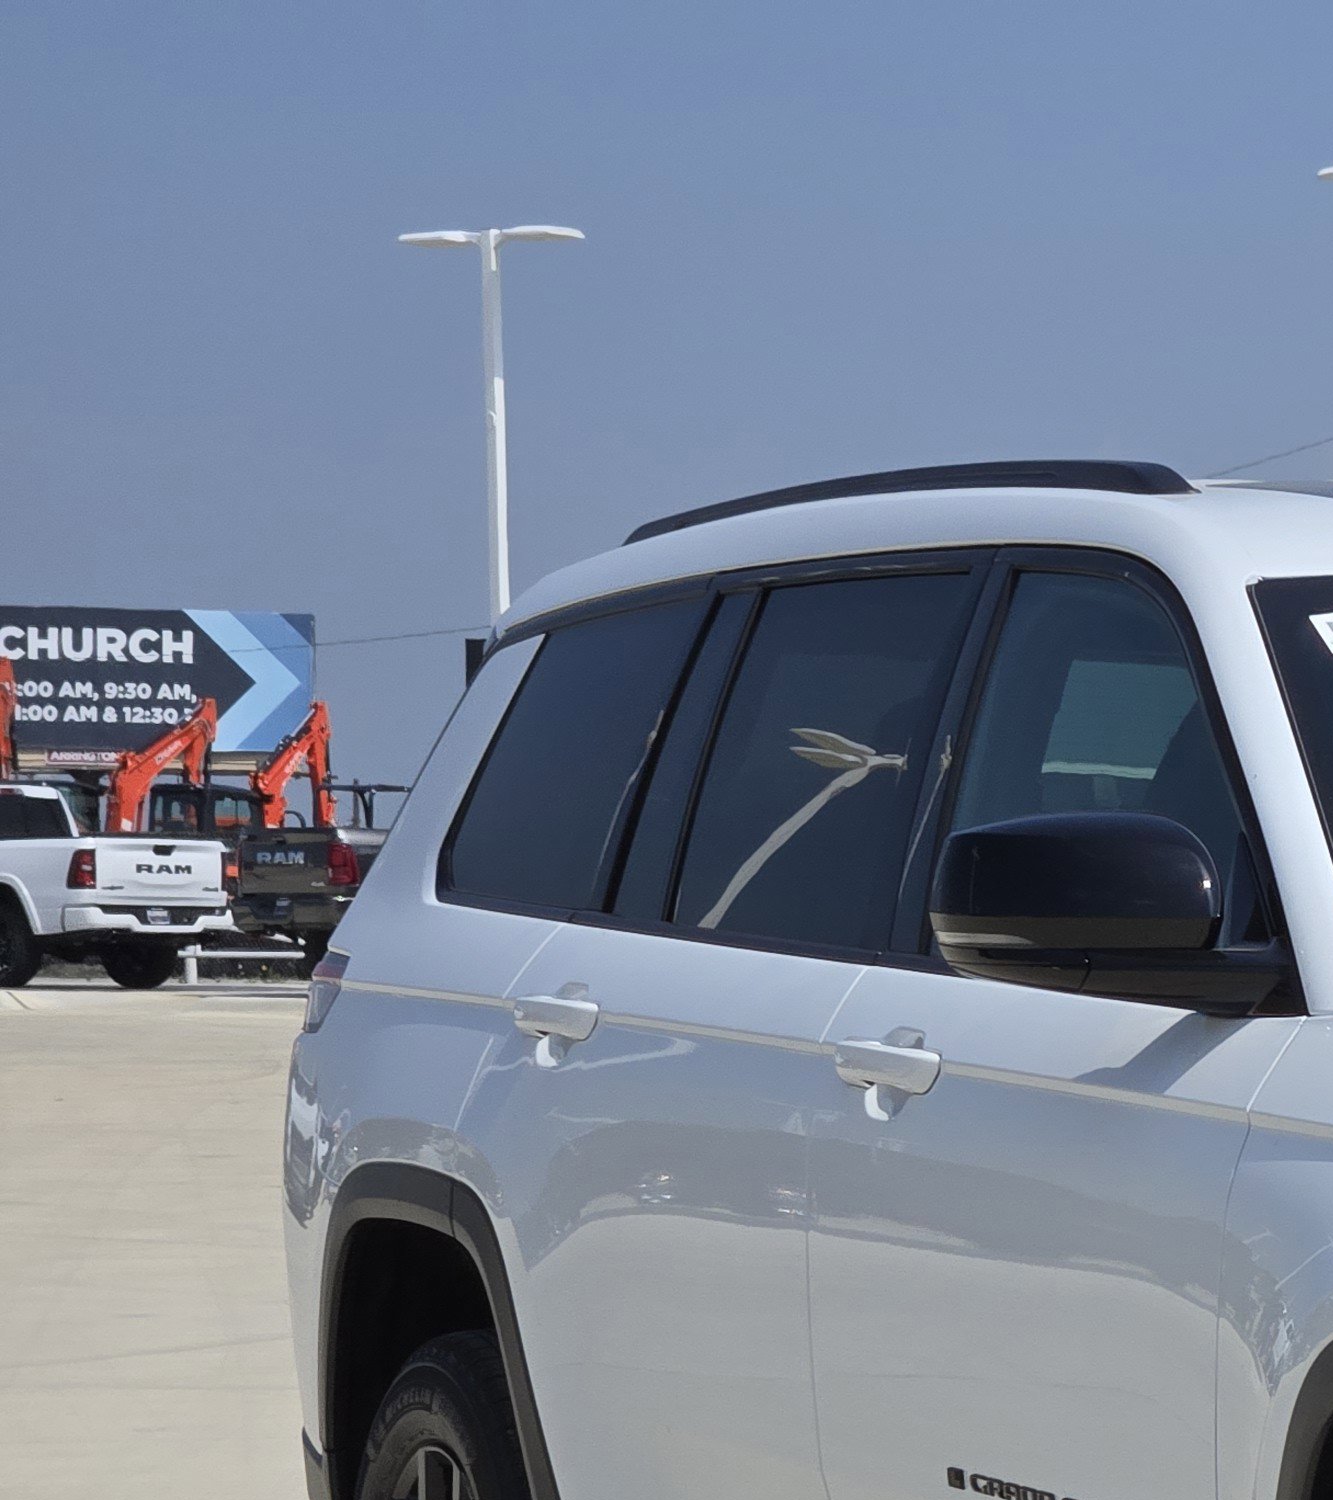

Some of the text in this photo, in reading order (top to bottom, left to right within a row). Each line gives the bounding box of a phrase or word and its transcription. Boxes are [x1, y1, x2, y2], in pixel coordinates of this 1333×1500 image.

[0, 626, 194, 664] CHURCH
[58, 681, 100, 701] AM,
[104, 682, 152, 699] 9:30
[156, 683, 198, 703] AM,
[63, 705, 98, 722] AM
[122, 706, 178, 724] 12:30
[256, 852, 305, 864] RAM
[135, 863, 192, 875] RAM
